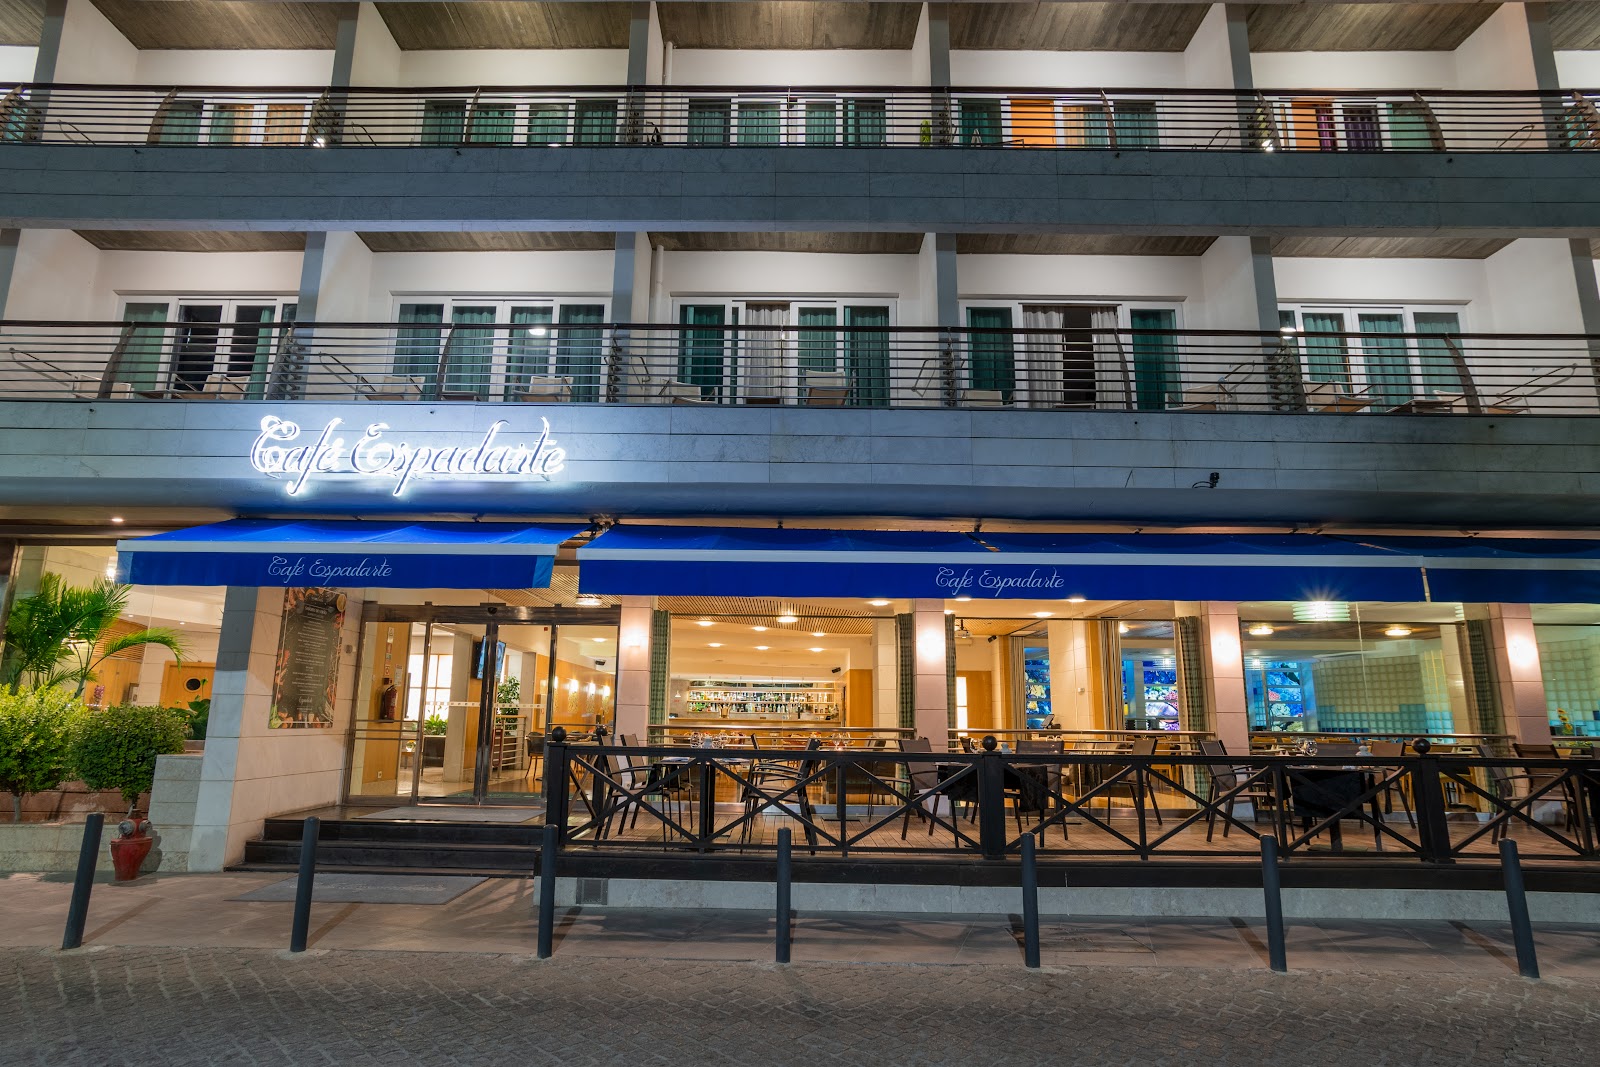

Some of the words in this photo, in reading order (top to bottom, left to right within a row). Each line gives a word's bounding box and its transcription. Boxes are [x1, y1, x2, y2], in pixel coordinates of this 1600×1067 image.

[350, 416, 567, 497] Espadarte
[267, 555, 305, 584] Café
[308, 556, 393, 586] Espadarte
[935, 566, 974, 596] Café
[978, 567, 1065, 598] Espadarte
